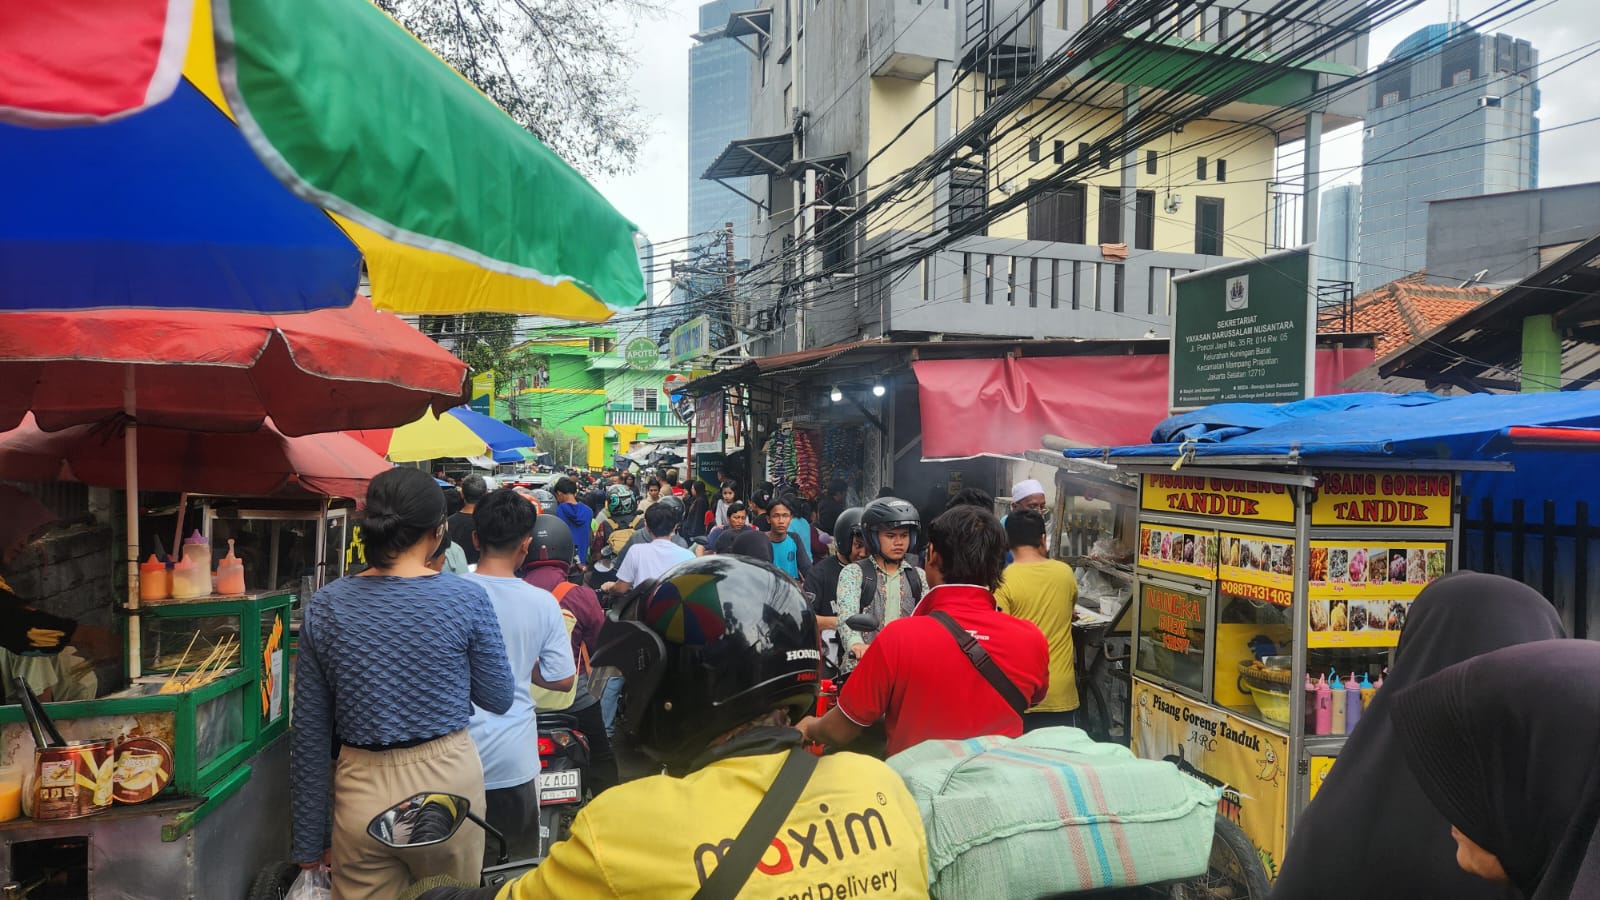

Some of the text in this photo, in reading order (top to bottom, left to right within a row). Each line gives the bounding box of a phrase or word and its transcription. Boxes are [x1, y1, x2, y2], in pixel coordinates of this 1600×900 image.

[1186, 320, 1294, 344] YAYASAN DARUSSALAM NUSANTARA
[1217, 315, 1258, 328] SEKRETARIAT
[627, 348, 658, 358] APOTEK
[1204, 346, 1271, 360] Kelurahan Kuningan Barat
[1197, 362, 1224, 372] Kecamatan
[1208, 372, 1226, 381] Jakarta
[1226, 370, 1246, 379] Selatan
[1313, 472, 1450, 496] PISANG GORENG
[1166, 492, 1259, 516] TANDUK
[1333, 500, 1428, 522] TANDUK
[1146, 588, 1200, 622] NANGKA
[1152, 694, 1260, 752] Pisang Goreng Tanduk
[818, 869, 898, 900] Delivery
